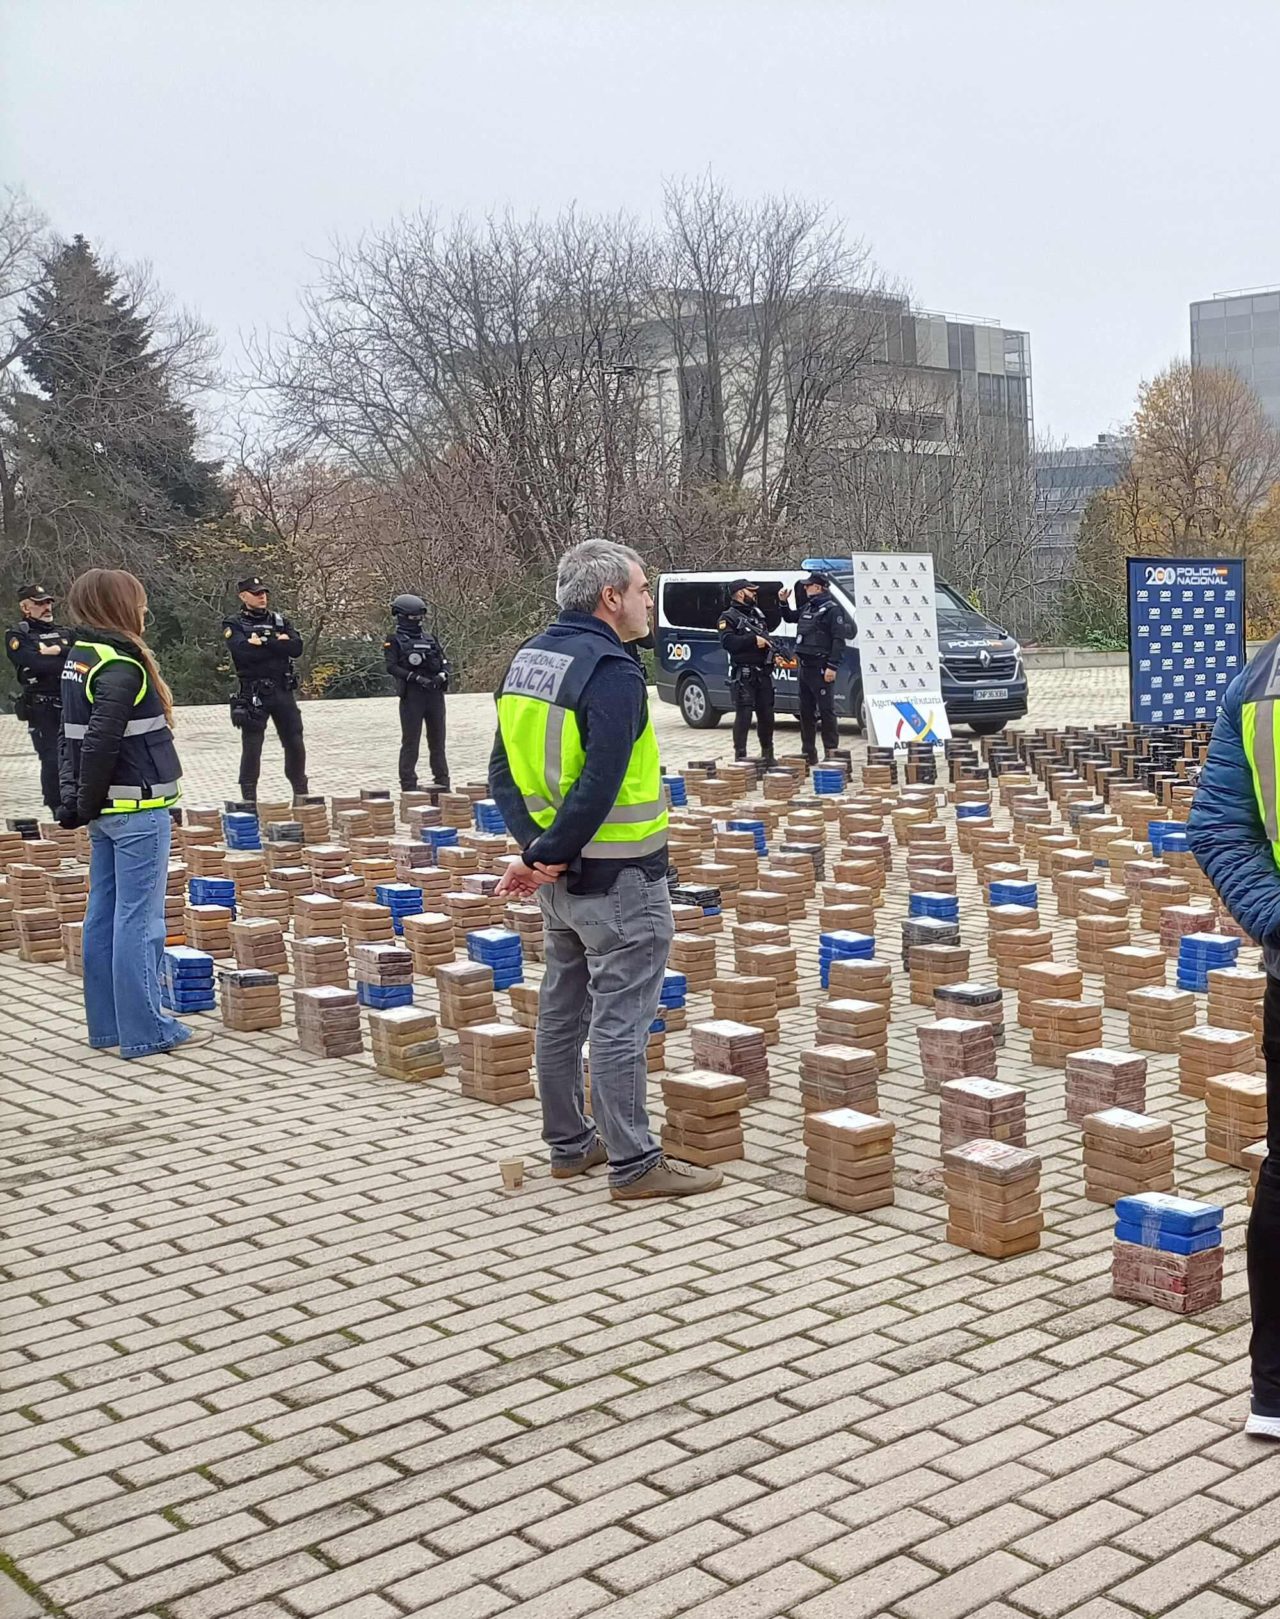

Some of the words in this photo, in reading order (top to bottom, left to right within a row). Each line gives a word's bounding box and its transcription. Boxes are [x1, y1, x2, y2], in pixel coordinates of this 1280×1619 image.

[1145, 567, 1176, 585] 200
[1177, 567, 1217, 576] POLICIA
[1177, 576, 1228, 585] NACIONAL
[667, 643, 692, 661] 200
[903, 695, 942, 705] Tributaria
